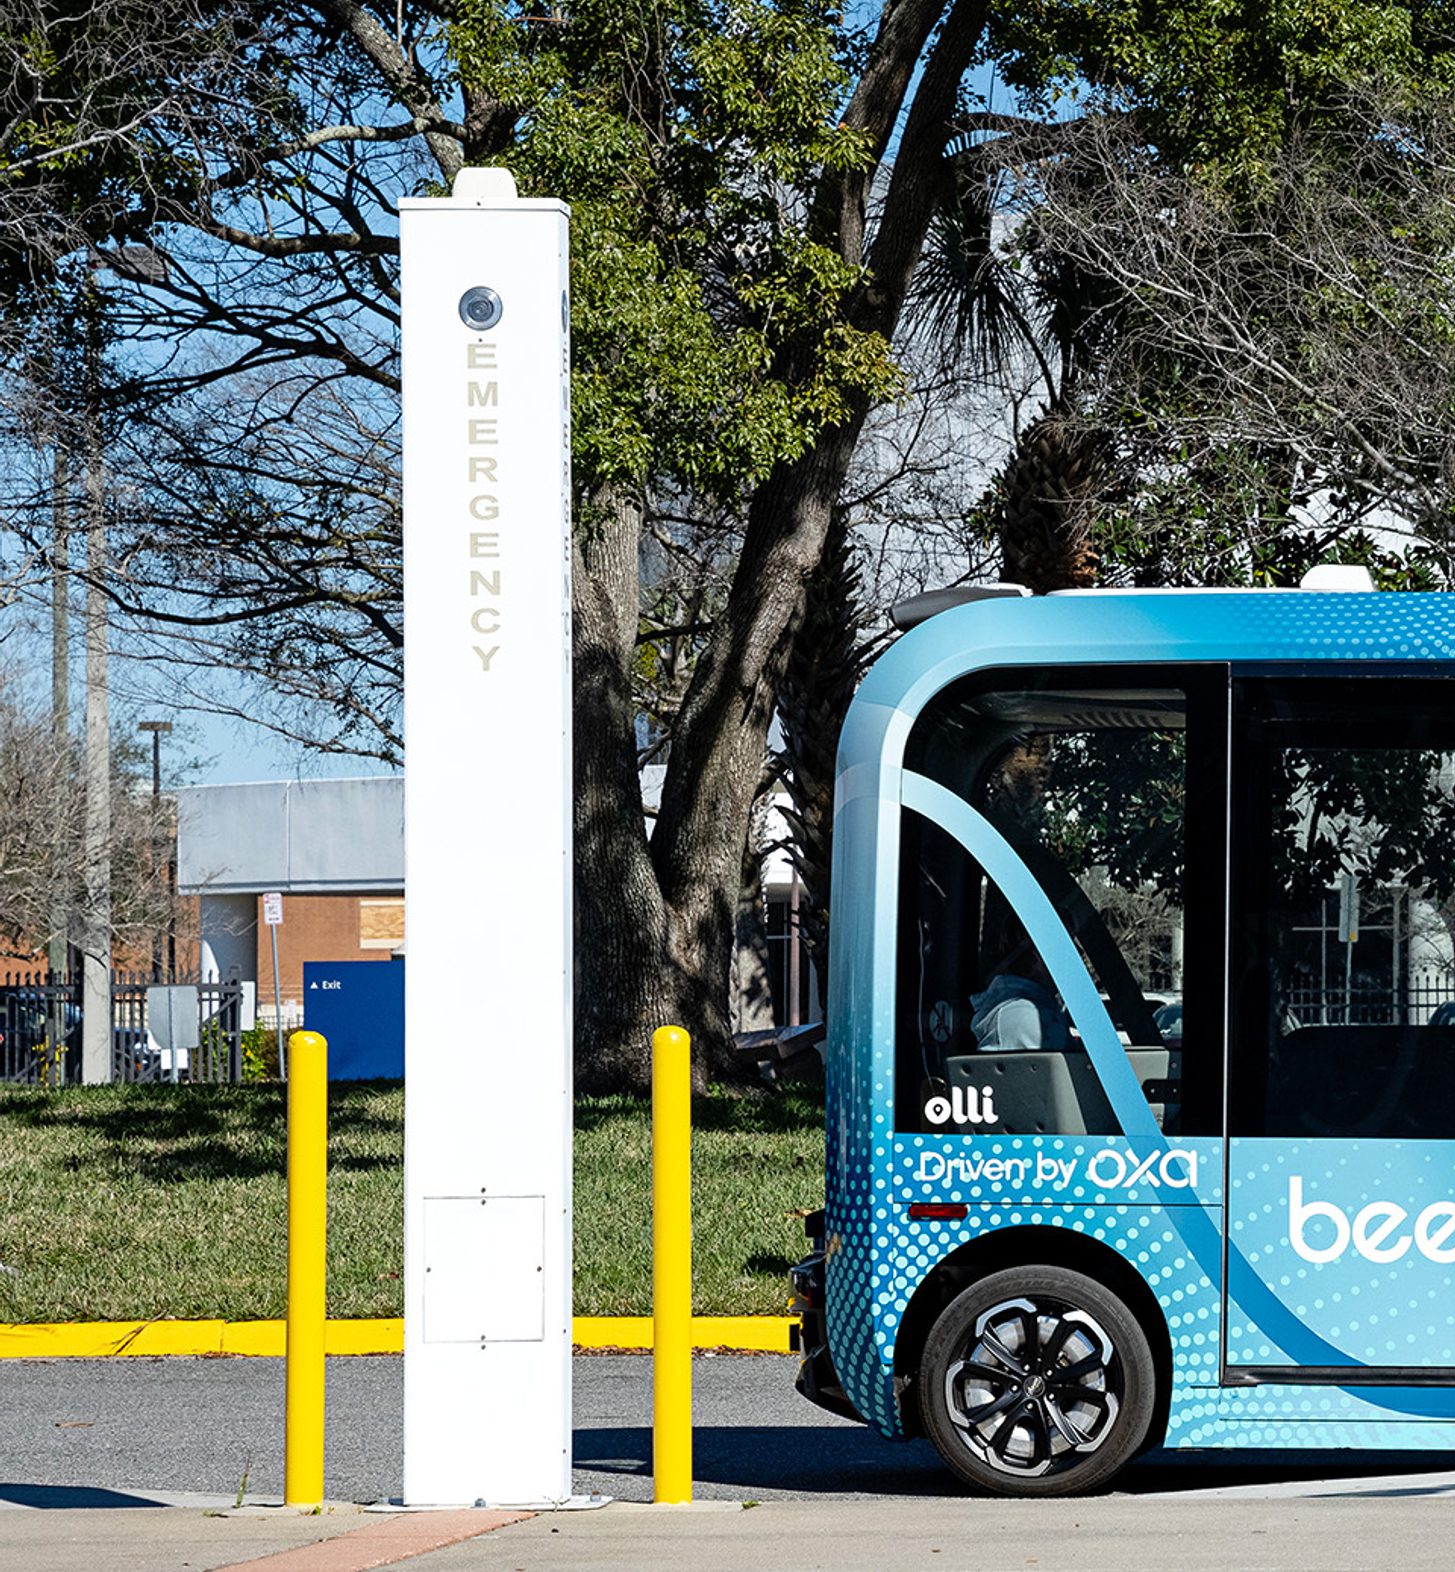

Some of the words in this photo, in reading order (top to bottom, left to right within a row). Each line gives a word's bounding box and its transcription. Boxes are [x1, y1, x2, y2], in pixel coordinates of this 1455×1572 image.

[467, 343, 501, 672] EMERGENCY
[322, 980, 341, 990] Exit
[924, 1085, 999, 1125] olli
[919, 1150, 1025, 1182] Driven
[1036, 1150, 1078, 1188] by
[1088, 1148, 1198, 1189] oxa
